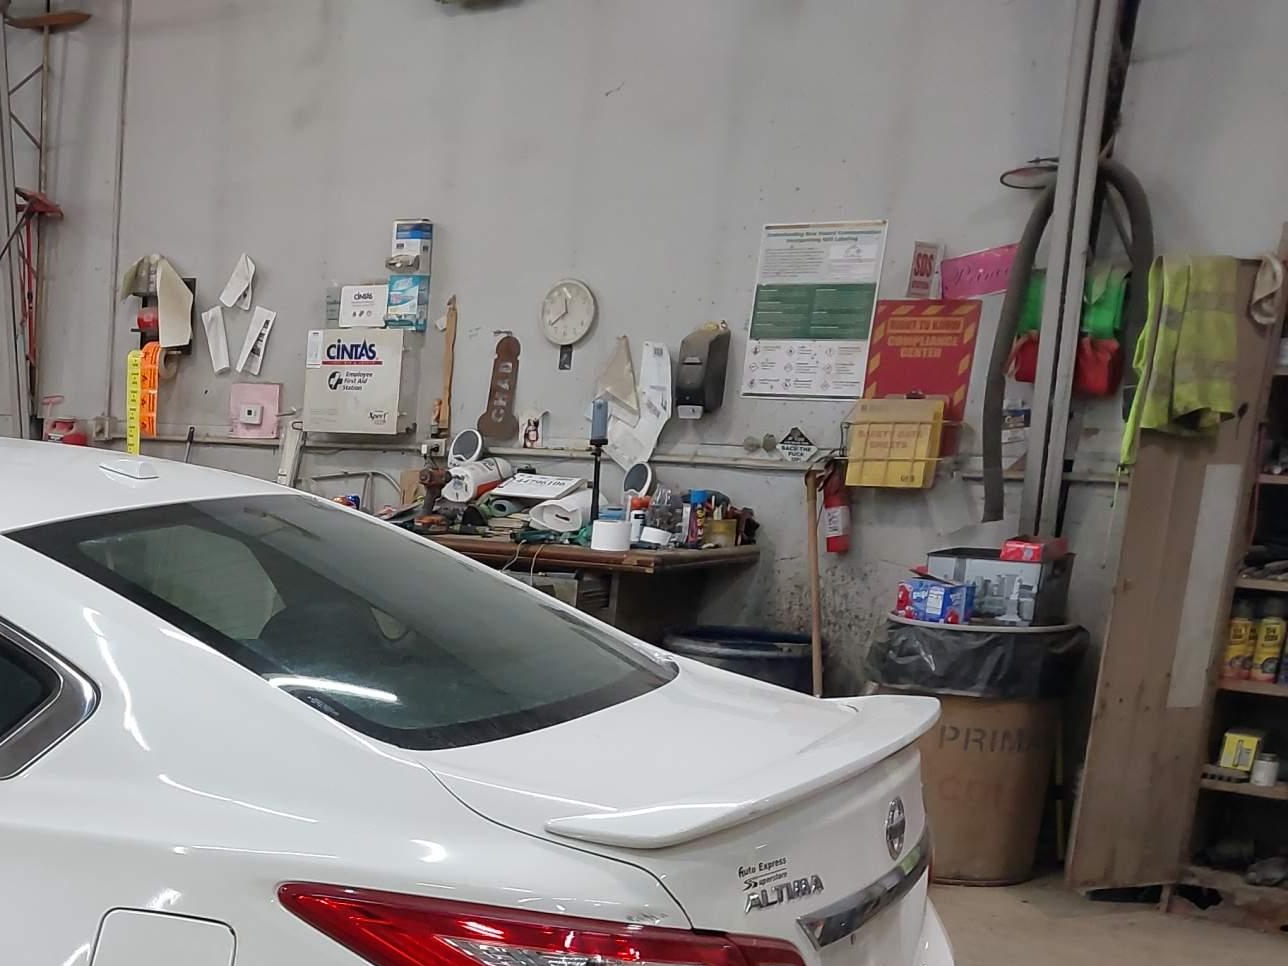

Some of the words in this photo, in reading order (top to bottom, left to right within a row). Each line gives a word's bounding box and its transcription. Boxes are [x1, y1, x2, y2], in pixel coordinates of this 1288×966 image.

[345, 371, 373, 379] Employee
[738, 866, 756, 878] Auto
[758, 857, 787, 872] Express
[744, 874, 824, 914] ALTIMA
